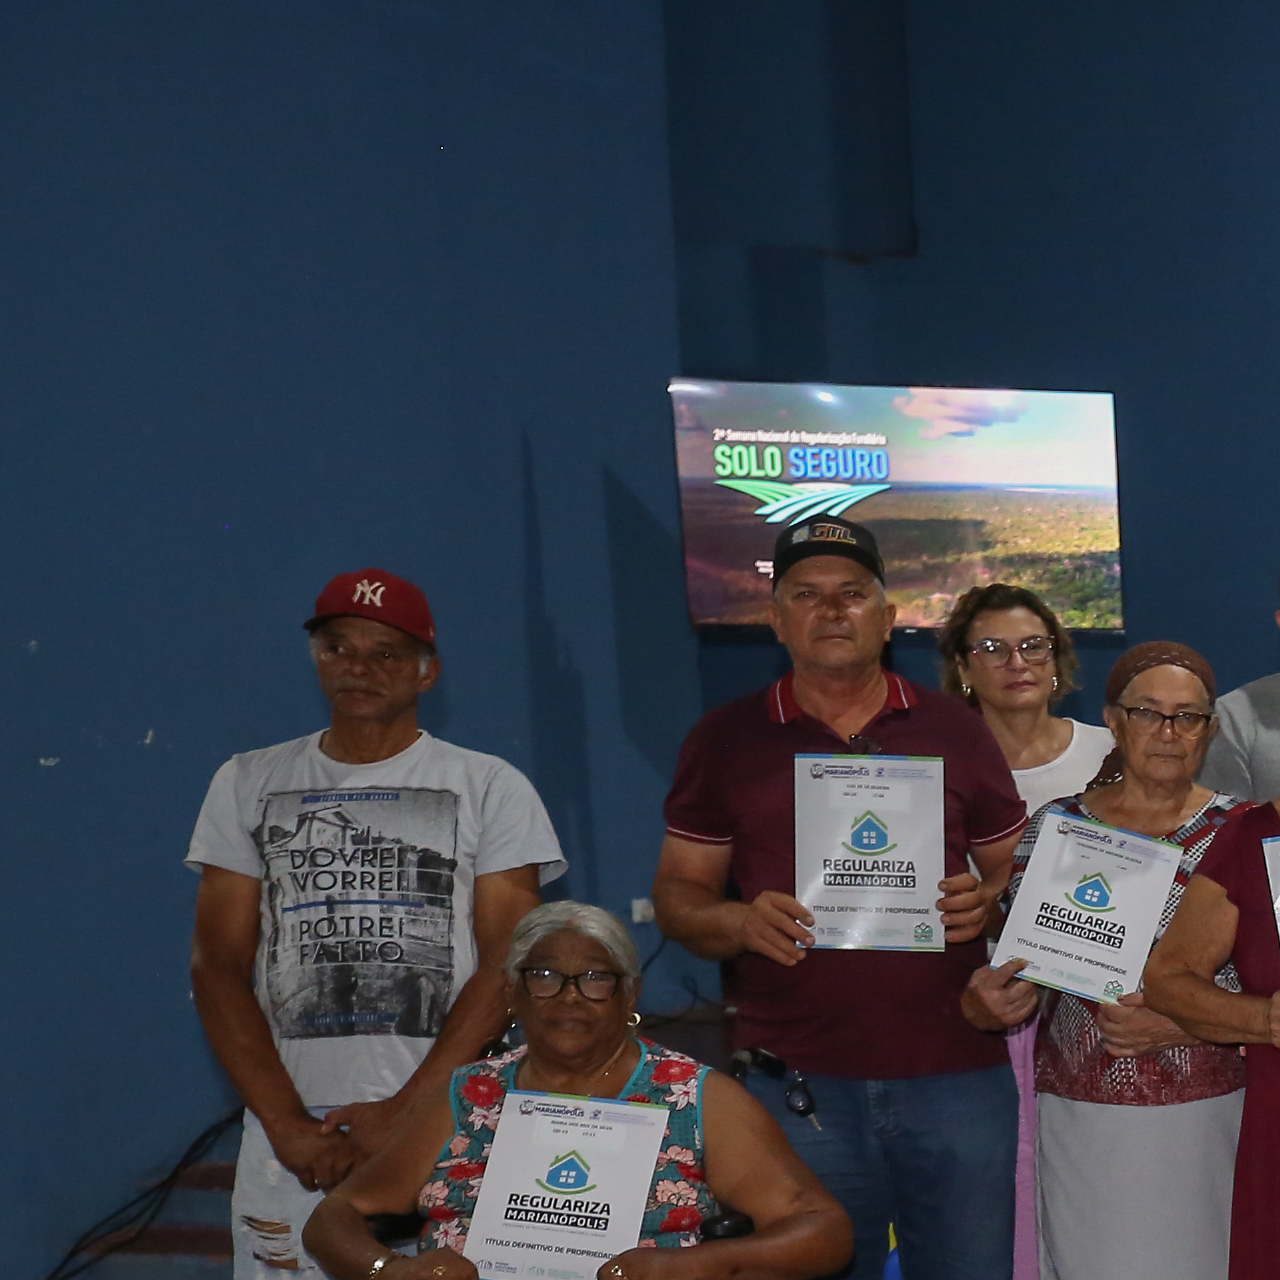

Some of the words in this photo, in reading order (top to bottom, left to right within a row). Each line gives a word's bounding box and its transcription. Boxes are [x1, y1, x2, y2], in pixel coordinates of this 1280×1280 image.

[757, 429, 790, 443] Nacional
[714, 444, 782, 477] SOLO
[788, 446, 889, 480] SEGURO
[352, 579, 386, 607] NY
[289, 848, 402, 870] DOVREI
[823, 859, 916, 873] REGULARIZA
[288, 871, 402, 893] VORREI
[824, 874, 915, 887] MARIANÓPOLIS
[299, 916, 405, 941] POTREI
[1039, 902, 1126, 937] REGULARIZA
[1036, 914, 1123, 948] MARIANÓPOLIS
[299, 941, 405, 966] FATTO
[1016, 938, 1039, 949] TÍTULO
[1039, 945, 1073, 959] DEFINITIVO
[1074, 954, 1083, 962] DE
[1084, 956, 1127, 976] PROPRIEDADE
[535, 1106, 585, 1118] MARIANÓPOLIS
[507, 1193, 611, 1216] REGULARIZA
[506, 1209, 608, 1230] MARIANÓPOLIS
[485, 1238, 511, 1247] TÍTULO
[512, 1241, 553, 1253] DEFINITIVO
[554, 1246, 564, 1254] DE
